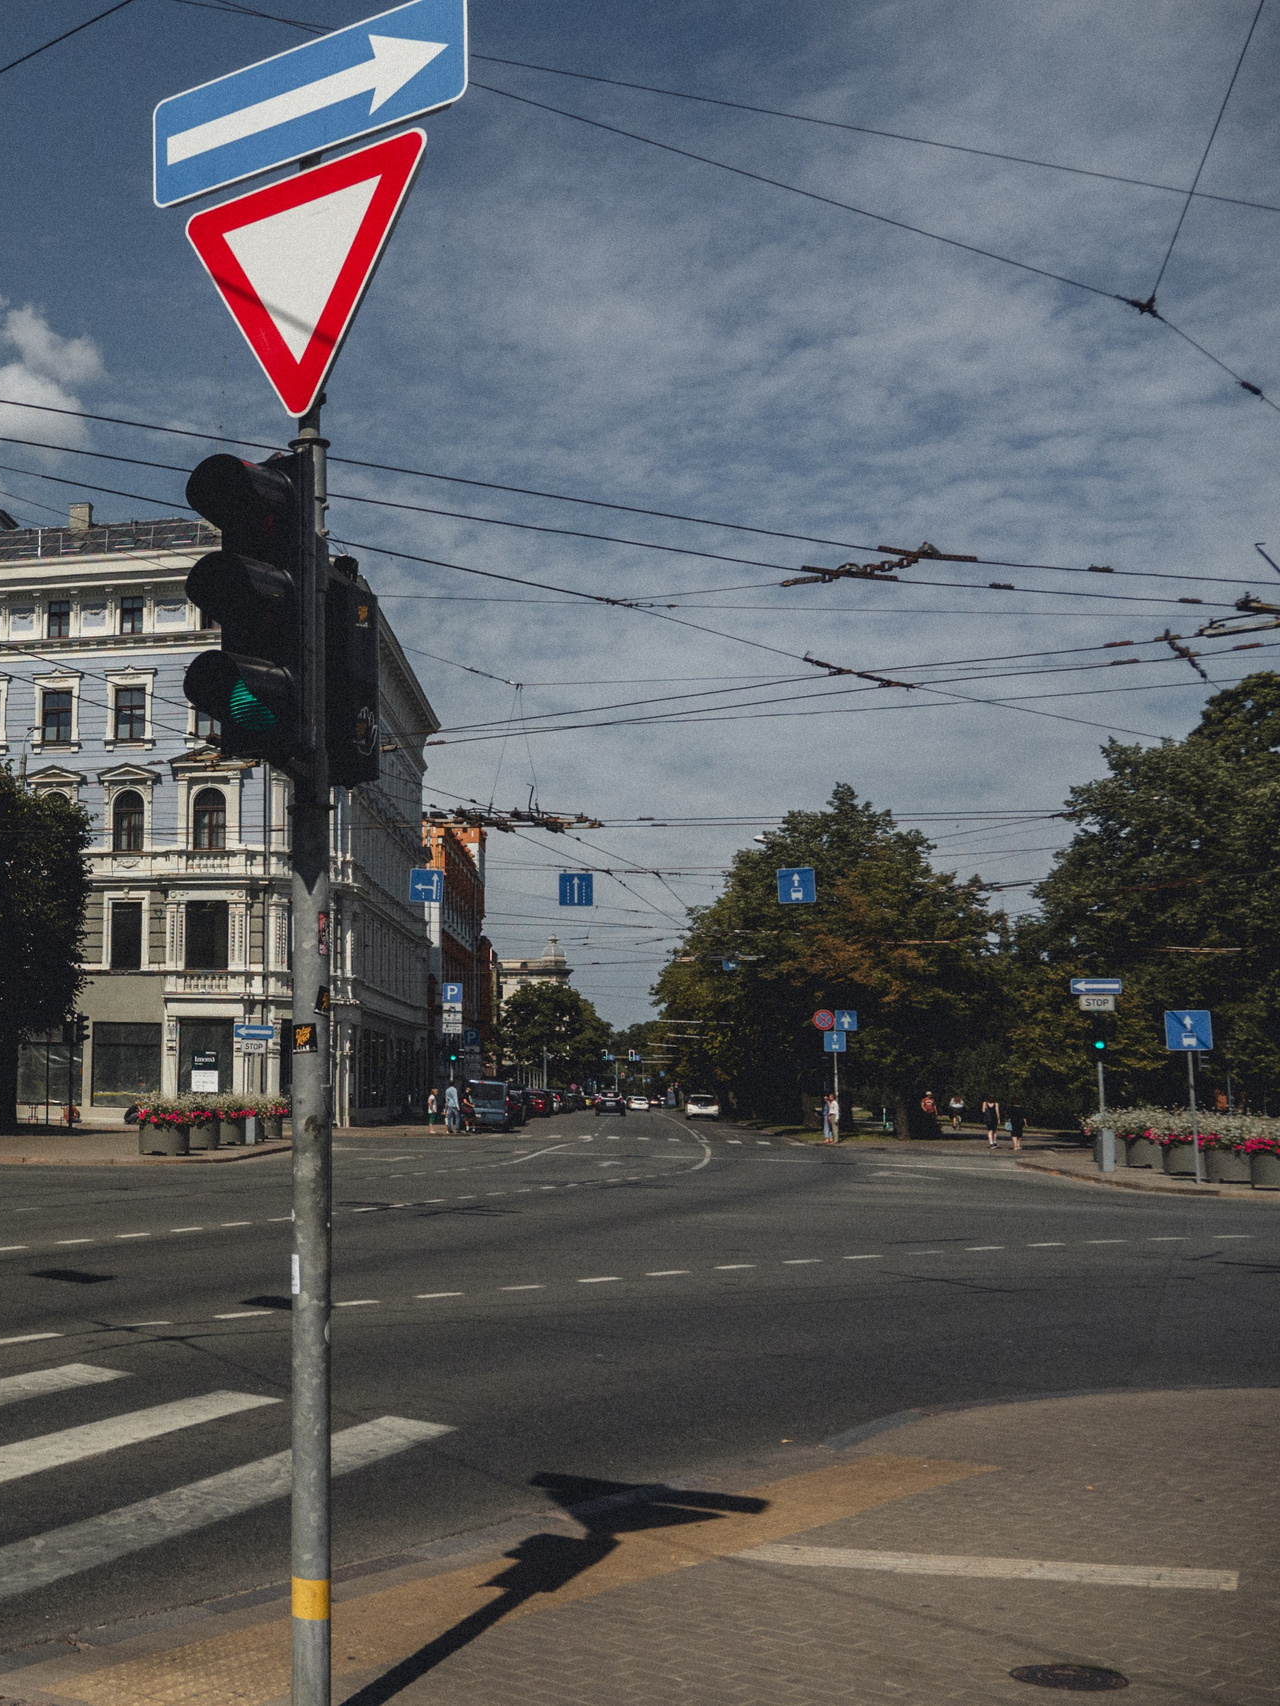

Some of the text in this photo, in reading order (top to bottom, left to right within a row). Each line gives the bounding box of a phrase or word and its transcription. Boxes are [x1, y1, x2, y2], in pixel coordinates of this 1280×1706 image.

[447, 986, 458, 1000] P
[1085, 998, 1109, 1007] STOP
[467, 1031, 475, 1043] P
